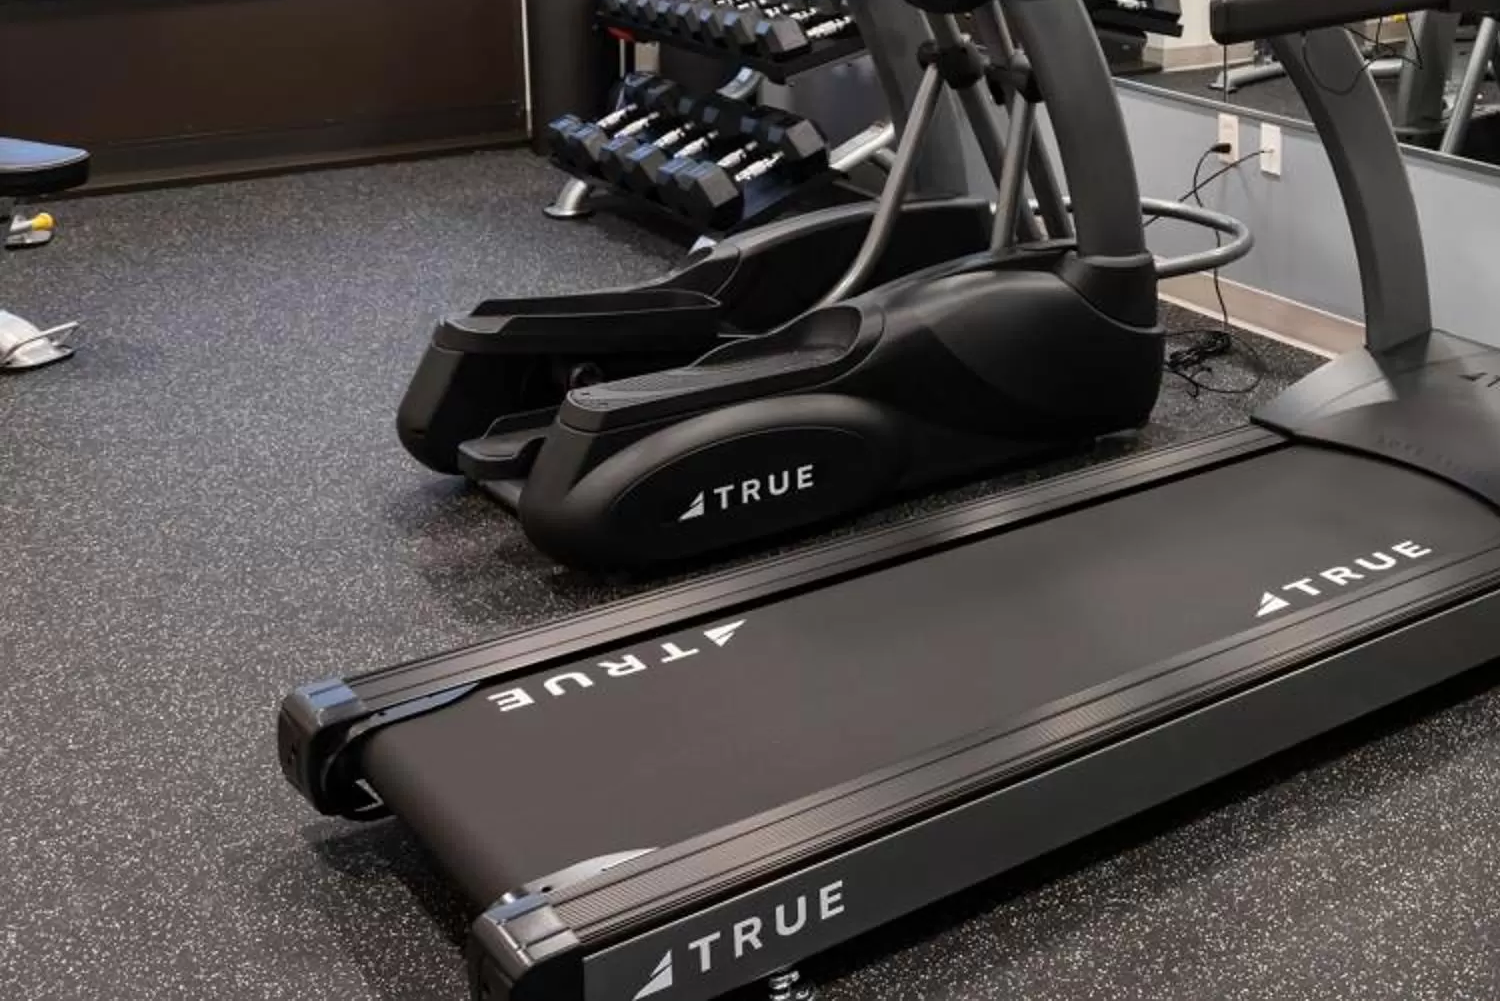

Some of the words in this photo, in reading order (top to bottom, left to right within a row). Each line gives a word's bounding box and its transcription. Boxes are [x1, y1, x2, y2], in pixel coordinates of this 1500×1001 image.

[713, 464, 814, 510] TRUE
[1281, 540, 1433, 596] TRUE
[486, 642, 700, 713] TRUE
[688, 879, 846, 974] TRUE
